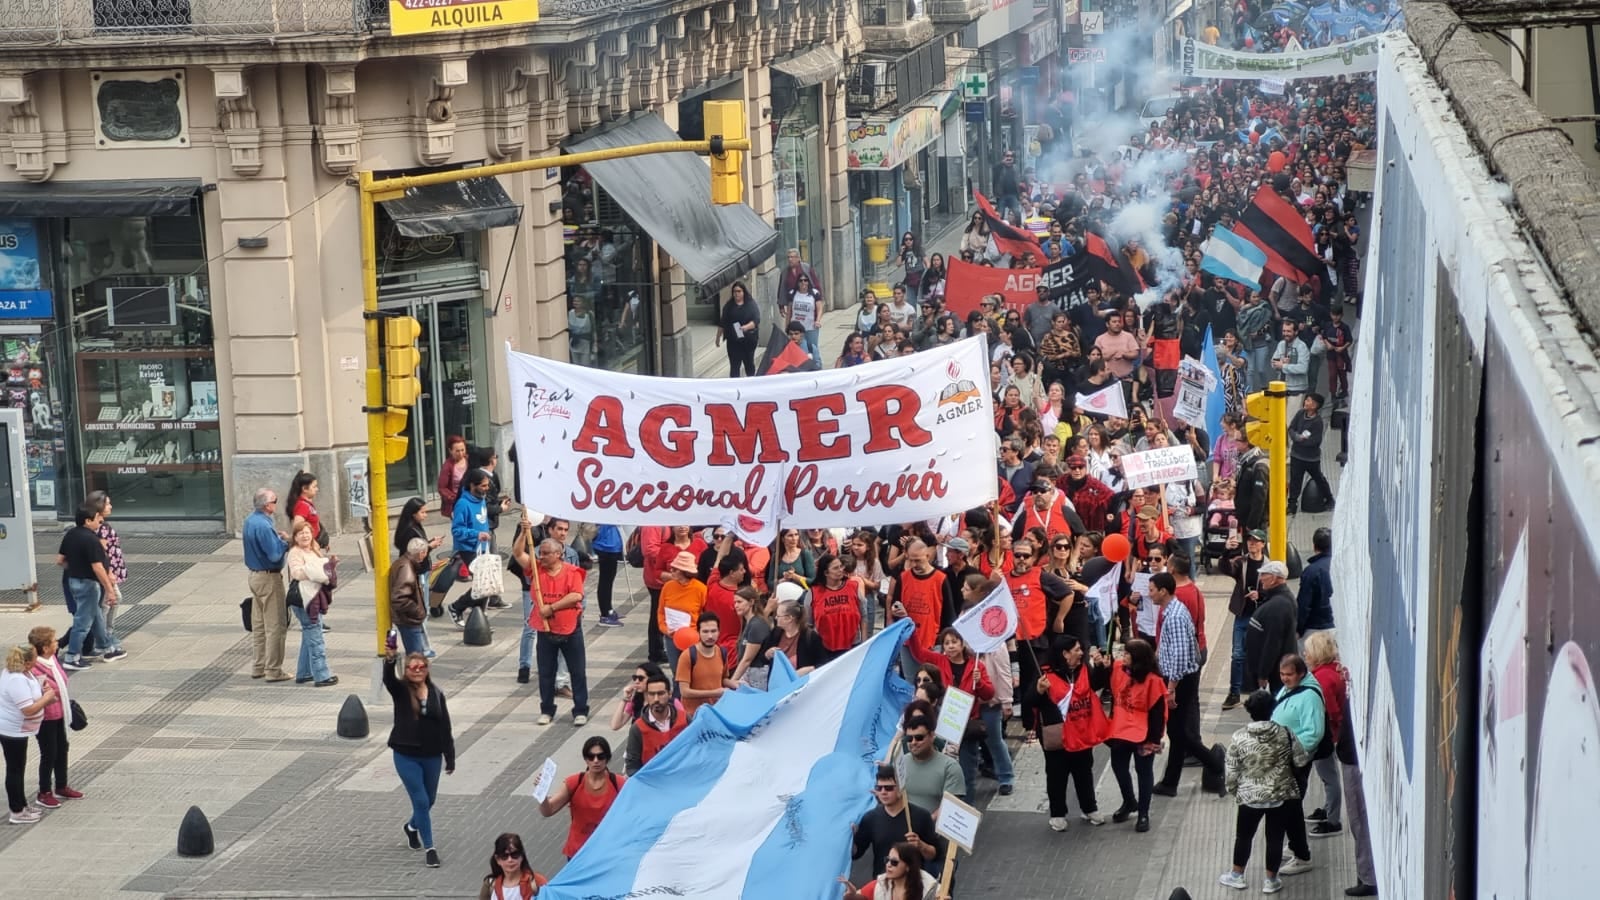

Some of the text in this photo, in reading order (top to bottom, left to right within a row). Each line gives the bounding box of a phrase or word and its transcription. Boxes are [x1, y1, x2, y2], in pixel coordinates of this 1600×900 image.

[431, 5, 503, 27] ALQUILA
[1004, 264, 1074, 292] AGMER
[453, 380, 475, 388] PROMO
[936, 398, 984, 424] AGMER
[572, 384, 933, 468] AGMER
[1145, 449, 1174, 461] A LOS
[571, 457, 949, 514] Seccional Paraná
[824, 594, 850, 608] AGMER
